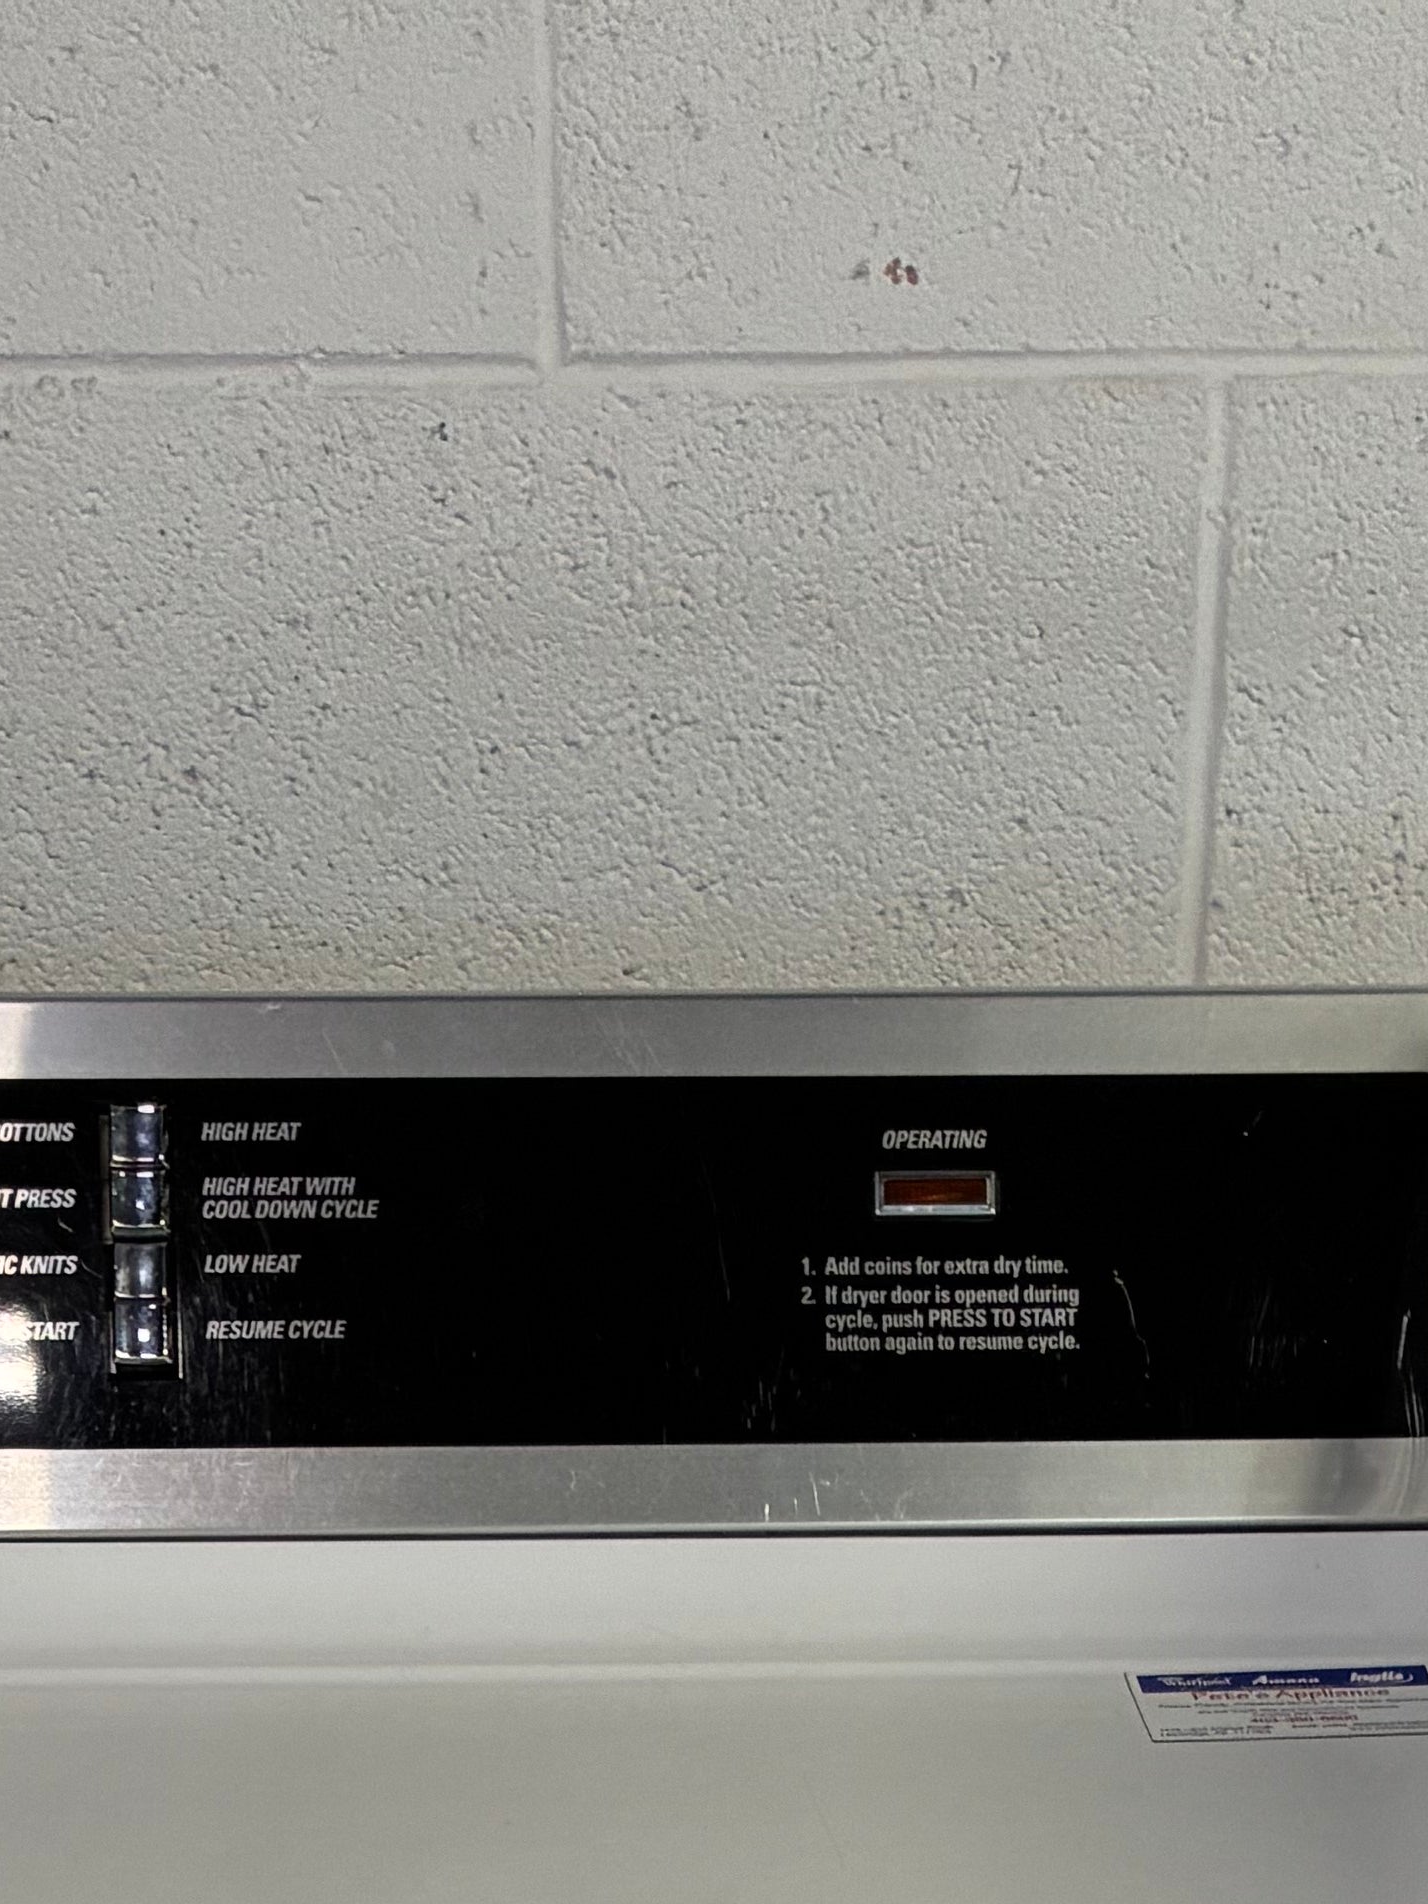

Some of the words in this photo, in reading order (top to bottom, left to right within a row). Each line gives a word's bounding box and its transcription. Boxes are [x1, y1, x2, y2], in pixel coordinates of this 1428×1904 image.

[201, 1121, 249, 1142] HIGH
[251, 1121, 302, 1142] HEAT
[882, 1129, 988, 1149] OPERATING
[202, 1177, 251, 1196] HIGH
[252, 1177, 303, 1196] HEAT
[305, 1177, 356, 1196] WITH
[14, 1188, 77, 1209] PRESS
[202, 1199, 252, 1219] COOL
[254, 1199, 318, 1219] DOWN
[320, 1199, 380, 1219] CYCLE
[20, 1255, 78, 1275] KNITS
[204, 1254, 250, 1273] LOW
[251, 1254, 302, 1273] HEAT
[801, 1256, 816, 1276] 1.
[824, 1256, 860, 1276] Add
[864, 1256, 913, 1276] coins
[915, 1256, 941, 1275] for
[944, 1257, 990, 1275] extra
[993, 1254, 1022, 1278] dry
[1025, 1254, 1069, 1274] time.
[801, 1286, 816, 1305] 2.
[825, 1285, 838, 1305] If
[841, 1285, 888, 1308] dryer
[891, 1285, 931, 1304] door
[934, 1284, 951, 1304] is
[954, 1284, 1019, 1308] opened
[1023, 1284, 1080, 1307] during
[205, 1320, 286, 1340] RESUME
[288, 1320, 348, 1340] CYCLE
[825, 1309, 879, 1333] cycle,
[882, 1309, 924, 1333] push
[928, 1308, 988, 1328] PRESS
[990, 1308, 1016, 1328] TO
[1019, 1308, 1079, 1328] START
[825, 1332, 881, 1352] button
[884, 1332, 934, 1355] again
[937, 1334, 955, 1350] to
[959, 1335, 1024, 1351] resume
[1027, 1330, 1081, 1354] cycle.
